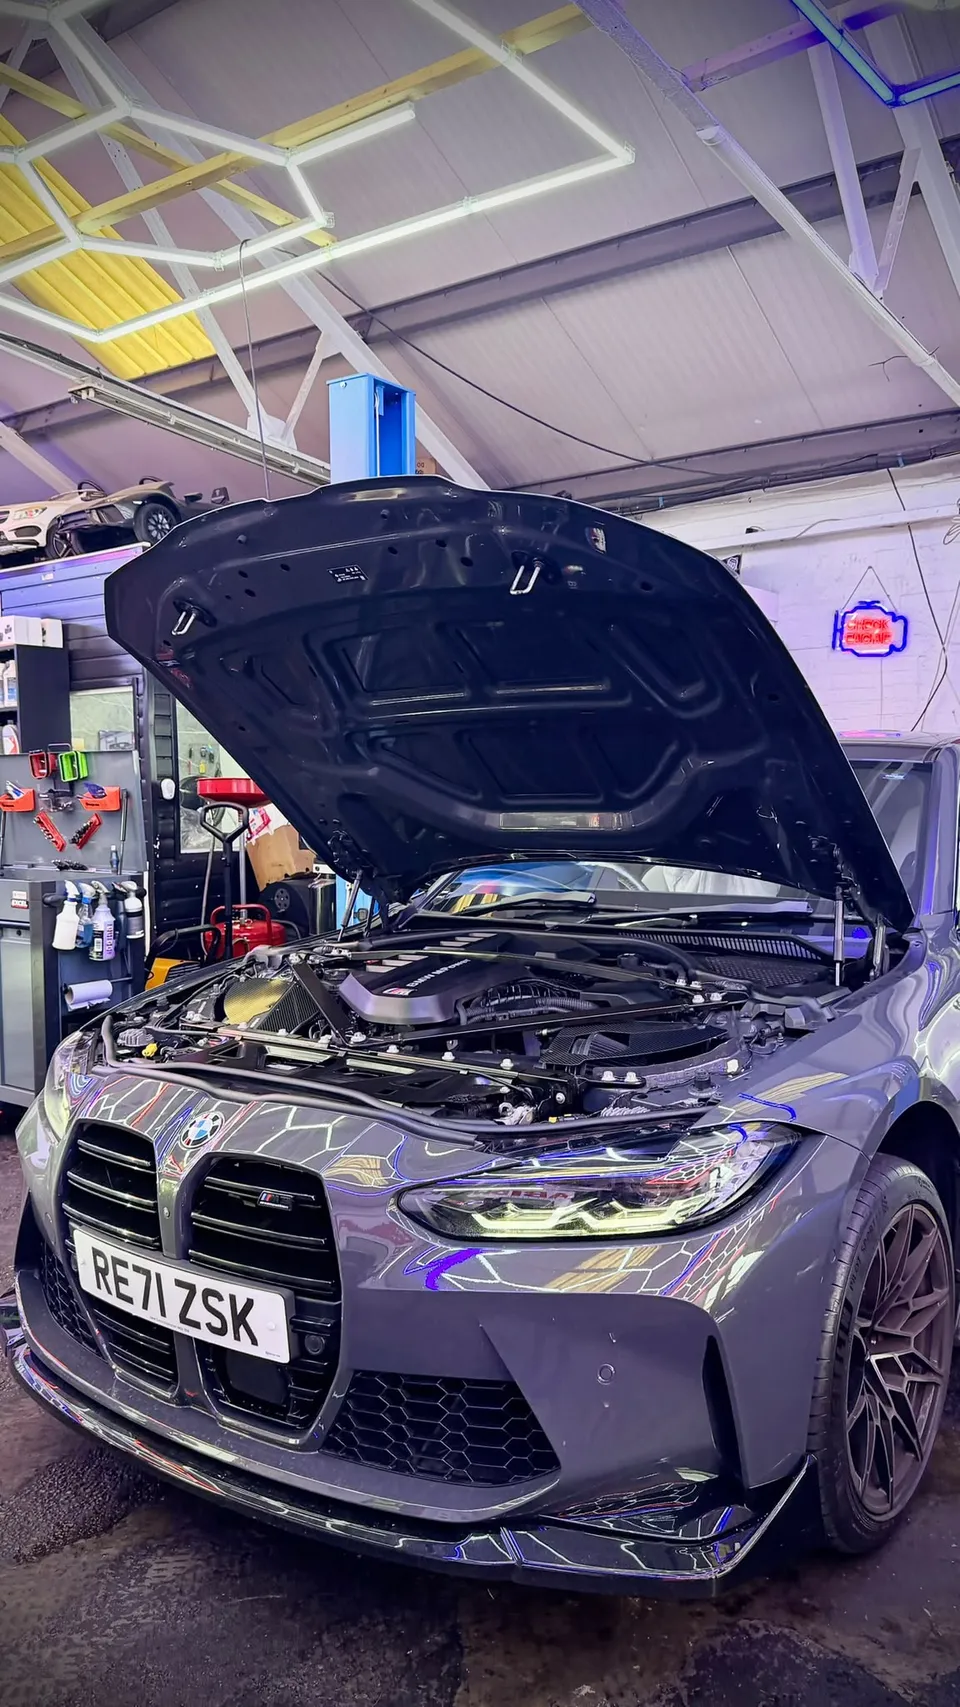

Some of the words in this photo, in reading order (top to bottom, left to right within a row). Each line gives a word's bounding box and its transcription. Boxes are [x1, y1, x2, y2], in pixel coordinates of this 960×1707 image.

[847, 619, 890, 631] CHECK
[846, 632, 892, 645] ENGINE
[406, 974, 436, 987] BMW
[91, 1246, 167, 1318] RE71
[174, 1278, 259, 1347] ZSK
